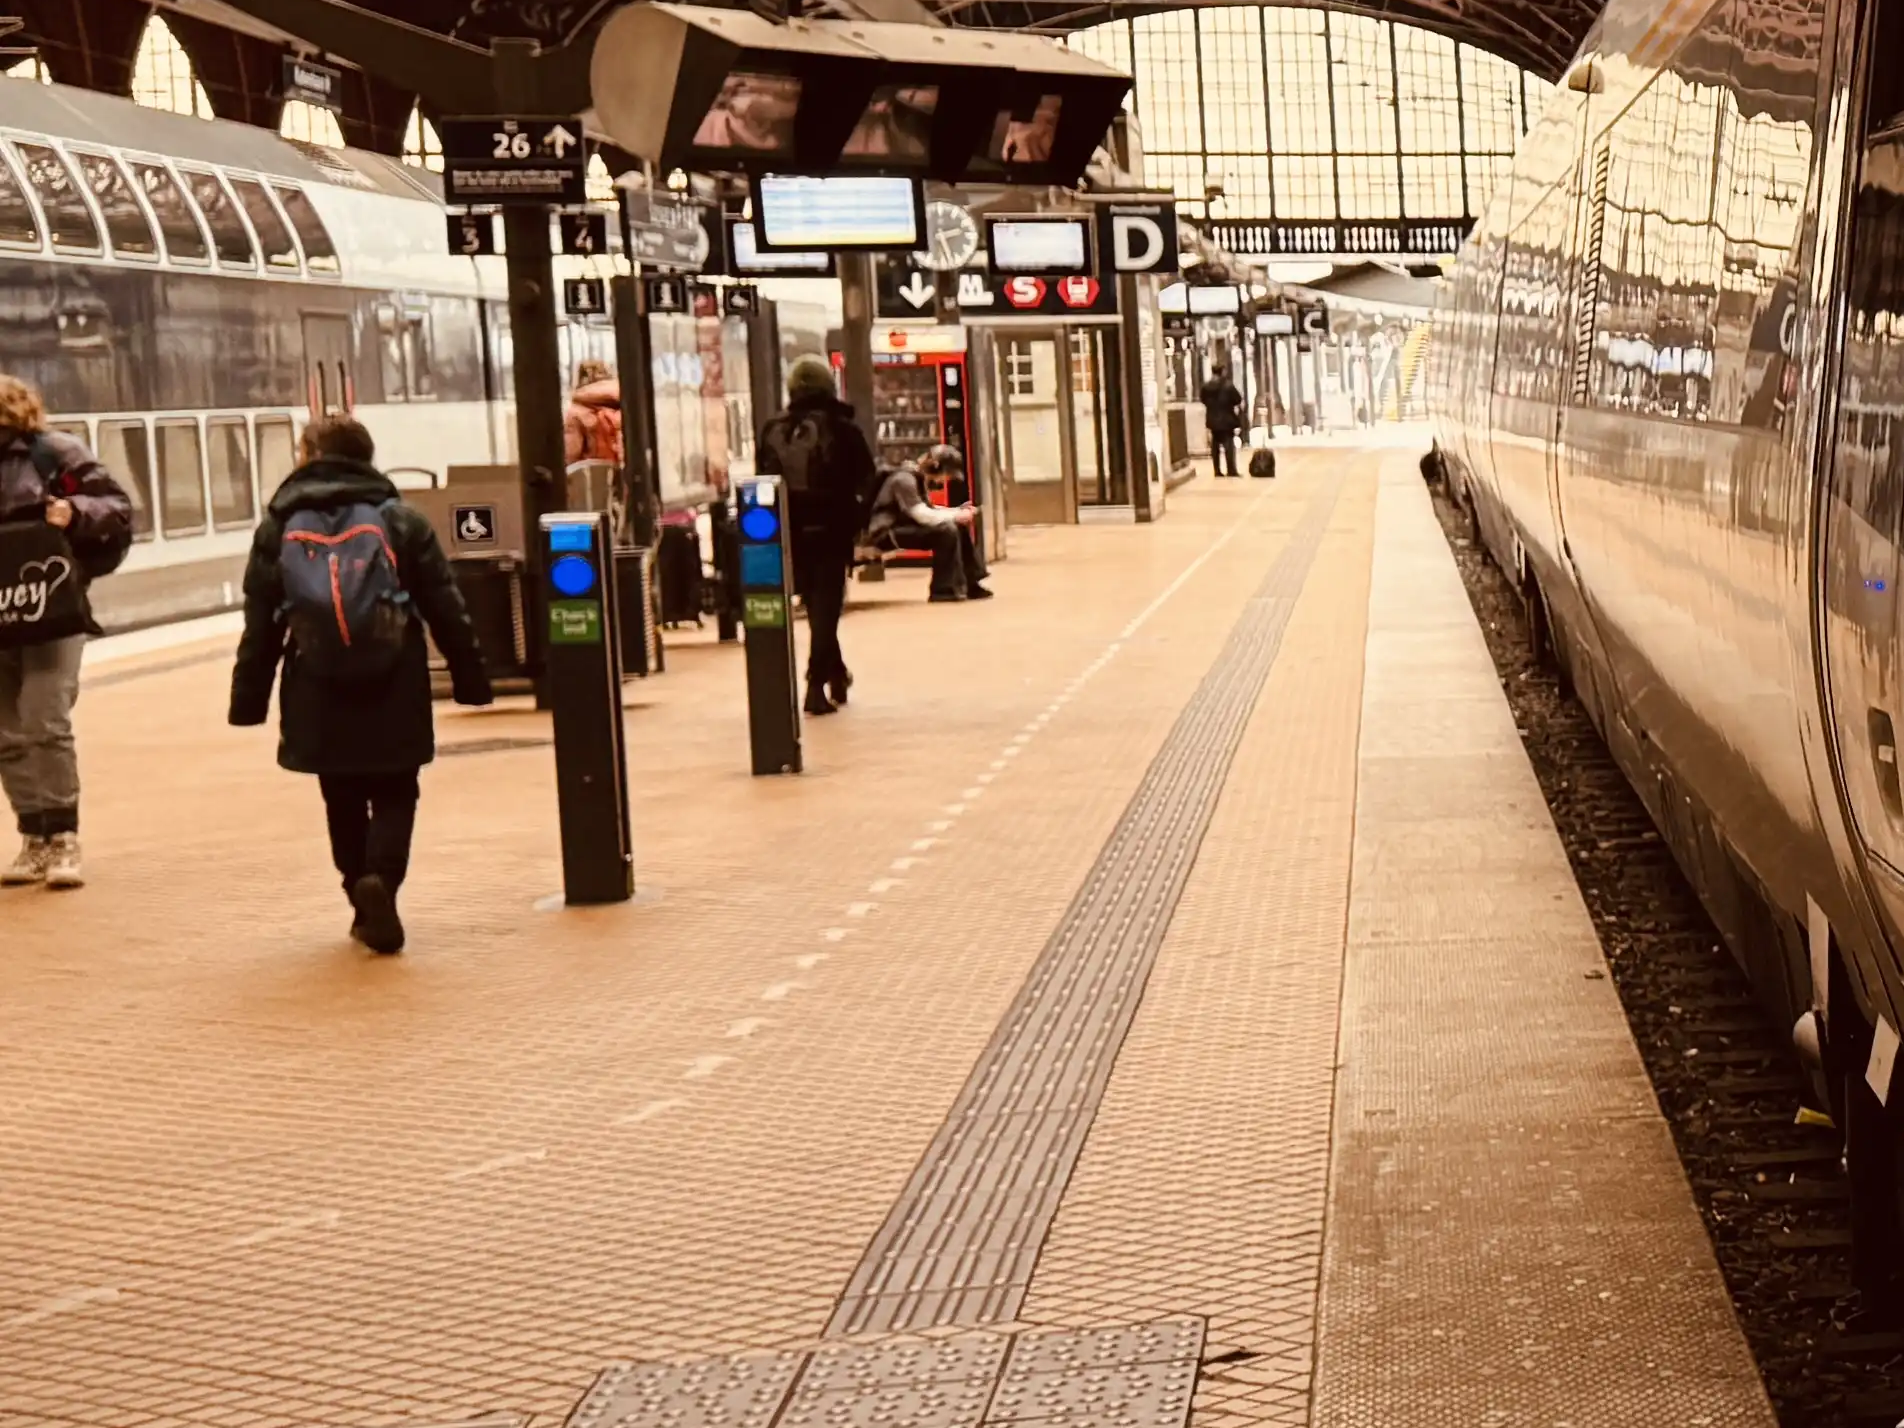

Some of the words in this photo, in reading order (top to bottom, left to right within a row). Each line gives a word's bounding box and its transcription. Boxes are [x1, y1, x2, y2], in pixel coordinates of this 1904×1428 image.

[492, 132, 531, 159] 26
[461, 225, 480, 253] 3
[574, 227, 593, 253] 4
[1113, 215, 1165, 271] D
[1011, 276, 1039, 303] S
